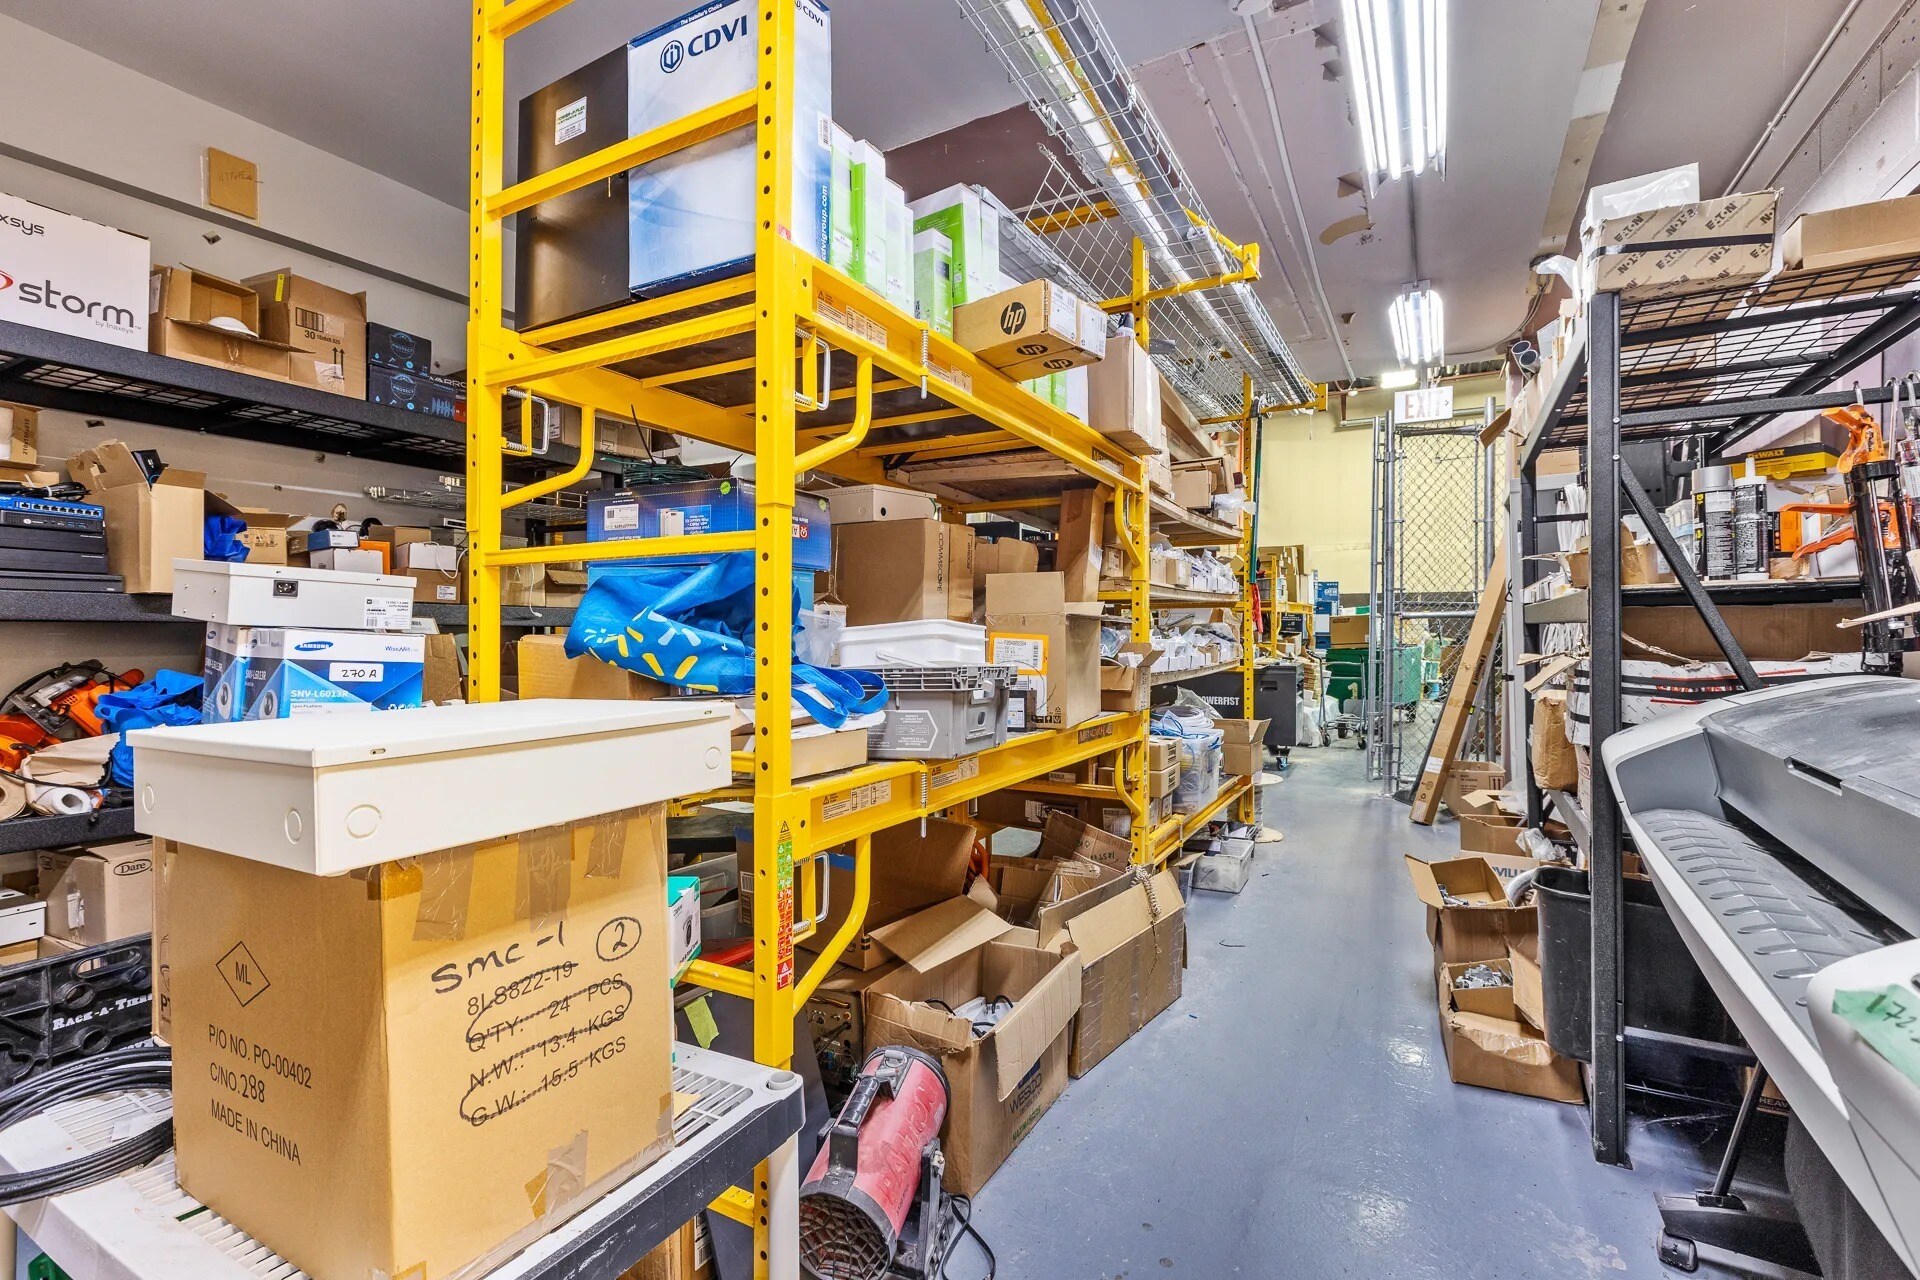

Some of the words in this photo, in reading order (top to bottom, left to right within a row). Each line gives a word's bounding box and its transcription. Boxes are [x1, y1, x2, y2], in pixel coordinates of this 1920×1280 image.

[803, 6, 823, 27] CDVI
[687, 14, 747, 57] CDVI
[18, 279, 134, 328] storm
[95, 320, 105, 328] by
[1002, 301, 1026, 336] hp
[304, 329, 316, 340] 30
[1023, 344, 1044, 356] hp
[1048, 359, 1069, 369] hp
[299, 642, 330, 650] SAMSUNG
[341, 668, 366, 679] 270
[368, 669, 377, 678] A
[290, 689, 350, 698] SNV-L6013R
[1200, 695, 1240, 706] OWERFIST
[120, 859, 147, 873] Dare
[235, 961, 252, 986] ML
[548, 995, 571, 1020] 24
[587, 972, 624, 1002] PCS
[540, 1026, 577, 1057] 13.4
[588, 1003, 626, 1035] KGS
[208, 1023, 227, 1050] P/O
[229, 1033, 251, 1061] NO.
[253, 1043, 312, 1090] PO-00402
[541, 1060, 578, 1092] 15.5
[589, 1035, 626, 1068] KGS
[211, 1098, 243, 1133] MADE
[246, 1117, 258, 1142] IN
[261, 1125, 302, 1166] CHINA
